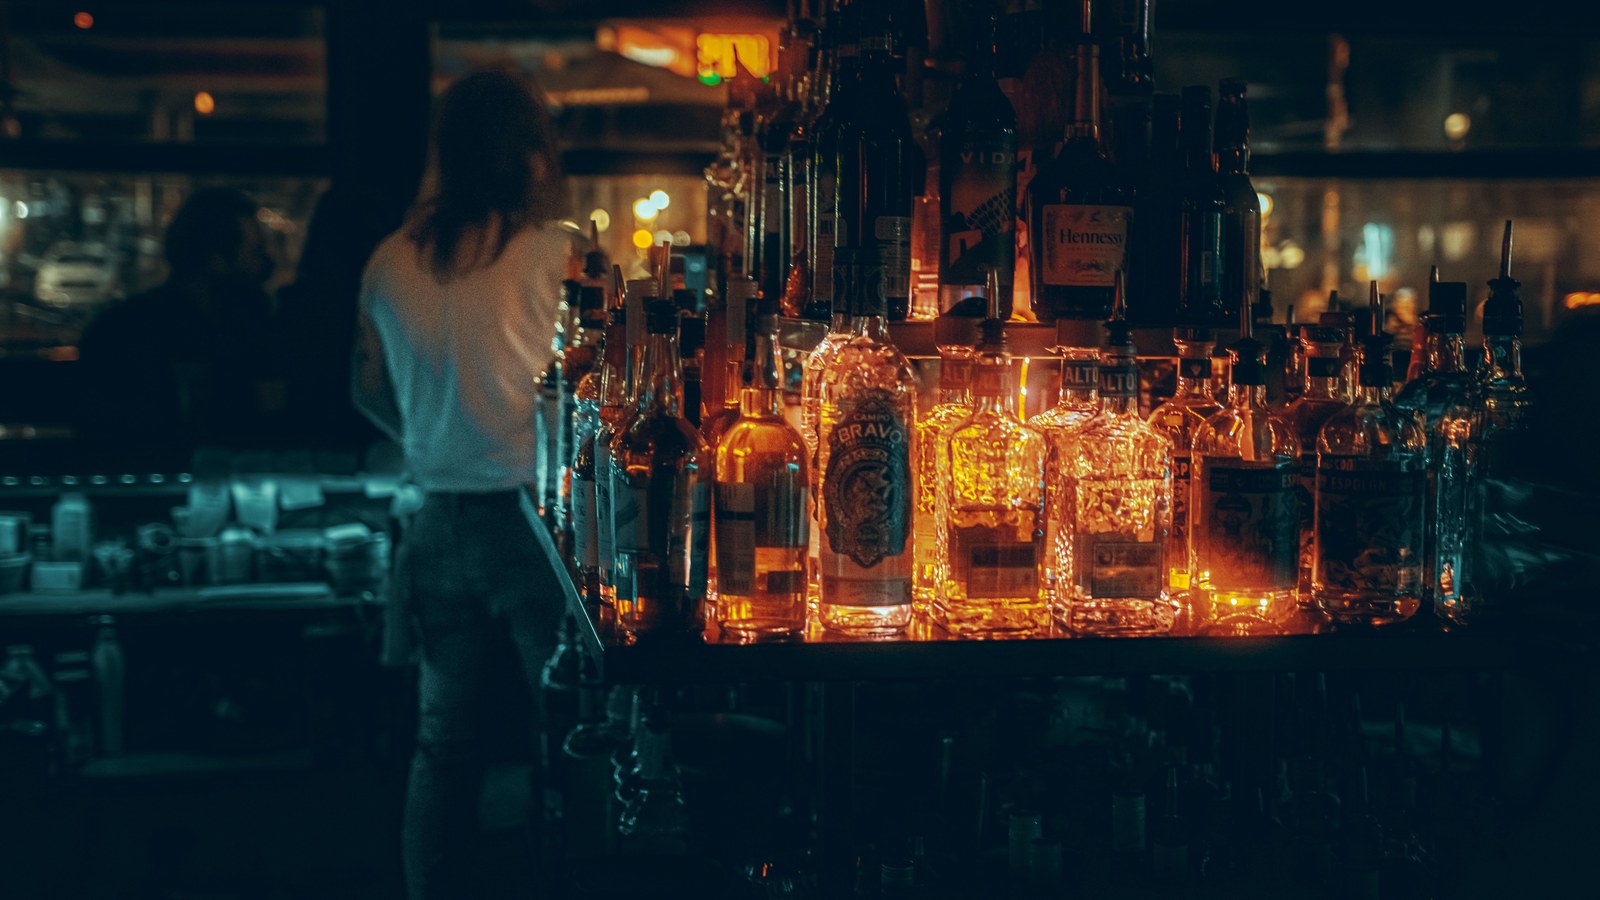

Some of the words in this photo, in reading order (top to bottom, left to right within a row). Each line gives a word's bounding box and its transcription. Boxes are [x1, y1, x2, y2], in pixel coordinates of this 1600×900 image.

[960, 152, 1015, 164] VIDA
[942, 365, 971, 384] ALT
[1065, 366, 1099, 384] ALTO
[838, 423, 902, 444] BRAVO
